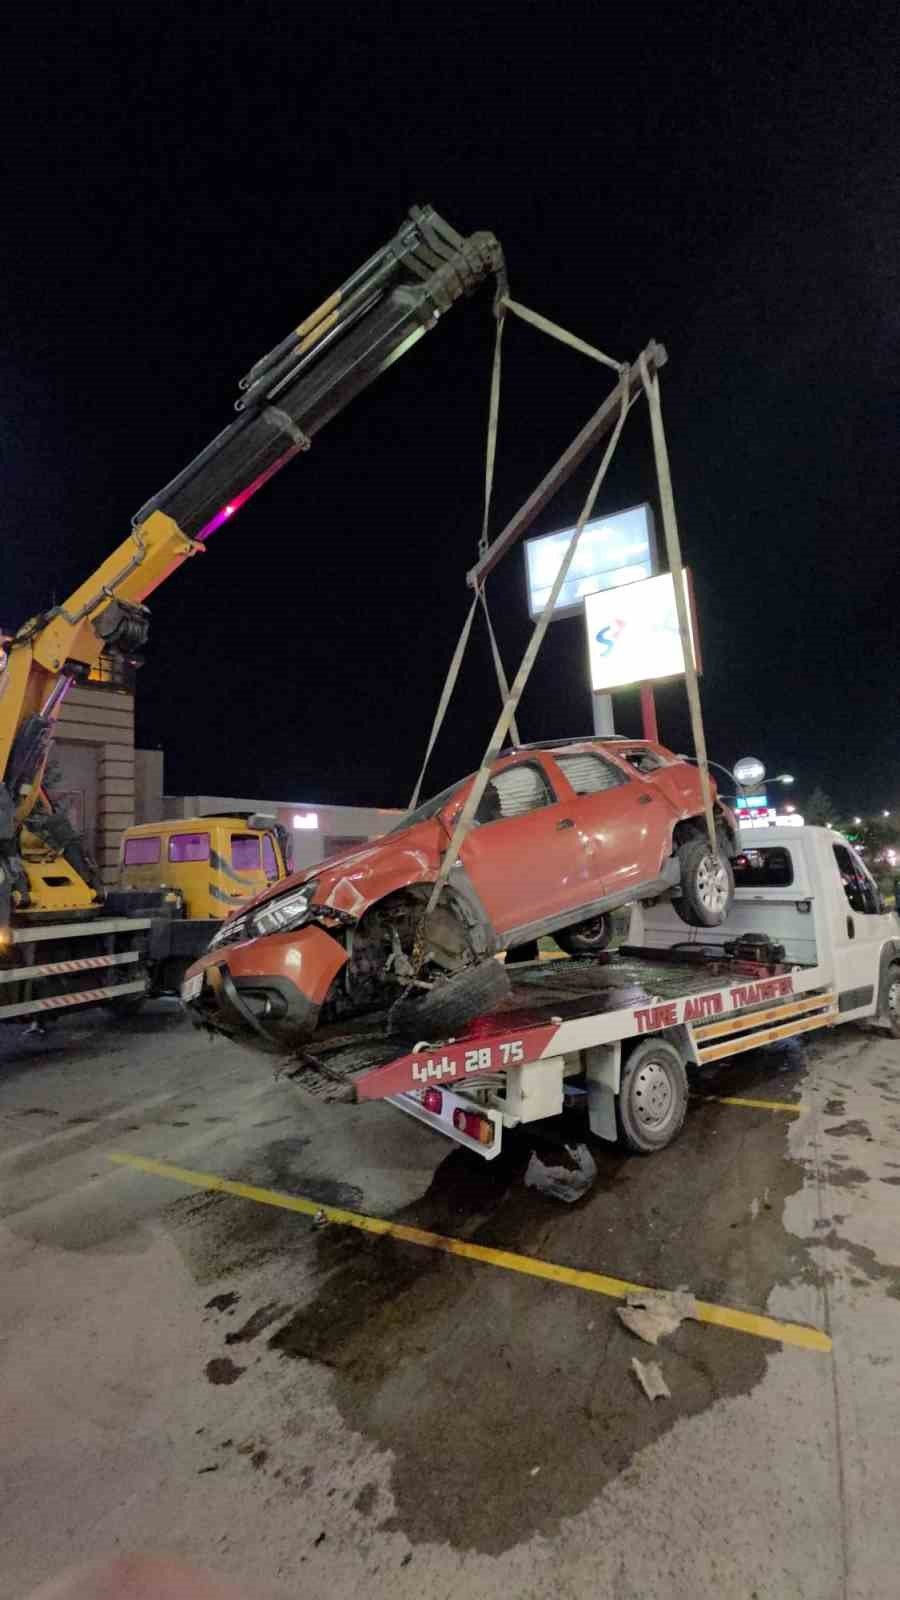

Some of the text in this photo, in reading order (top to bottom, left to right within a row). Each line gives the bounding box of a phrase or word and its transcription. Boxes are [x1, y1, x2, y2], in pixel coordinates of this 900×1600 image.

[683, 993, 723, 1021] AUTO
[730, 977, 793, 1008] TRANSFER
[412, 1040, 524, 1083] 444 28 75
